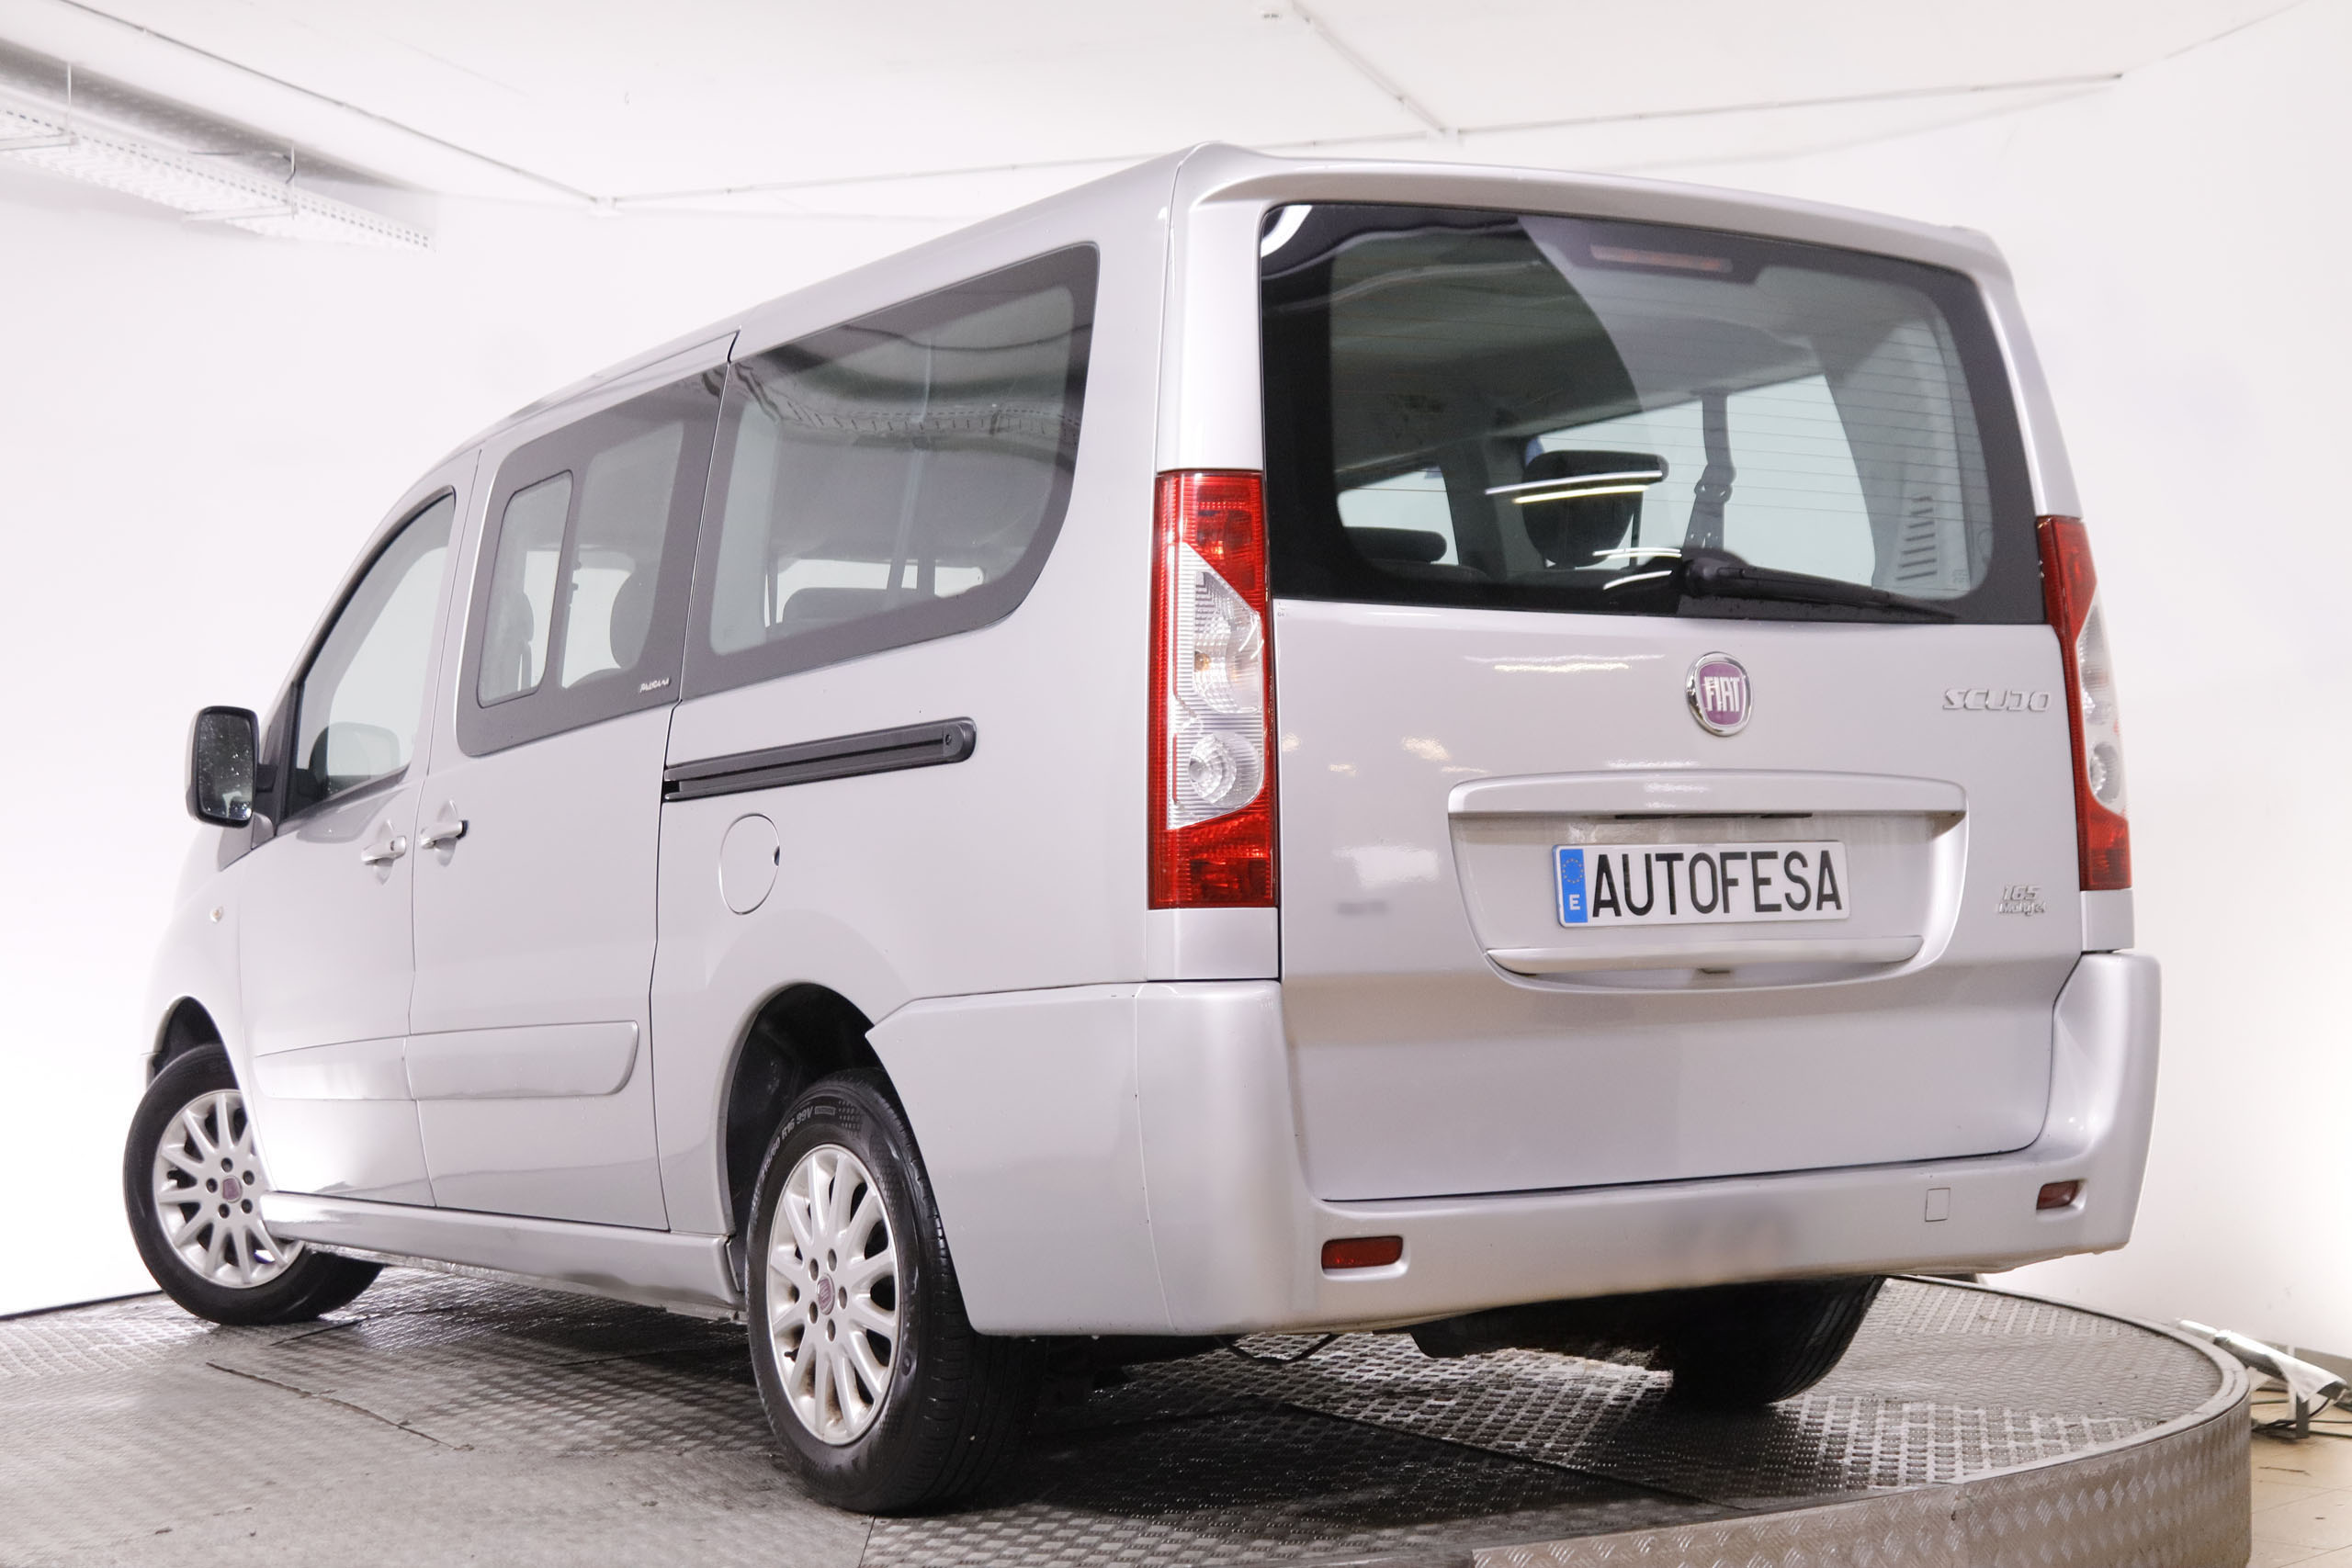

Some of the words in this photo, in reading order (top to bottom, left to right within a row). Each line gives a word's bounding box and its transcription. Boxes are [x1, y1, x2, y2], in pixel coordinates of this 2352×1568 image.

[1704, 676, 1740, 712] FIAT
[1942, 689, 2051, 712] SCUDO
[1592, 850, 1842, 918] AUTOFESA
[1569, 894, 1580, 910] E
